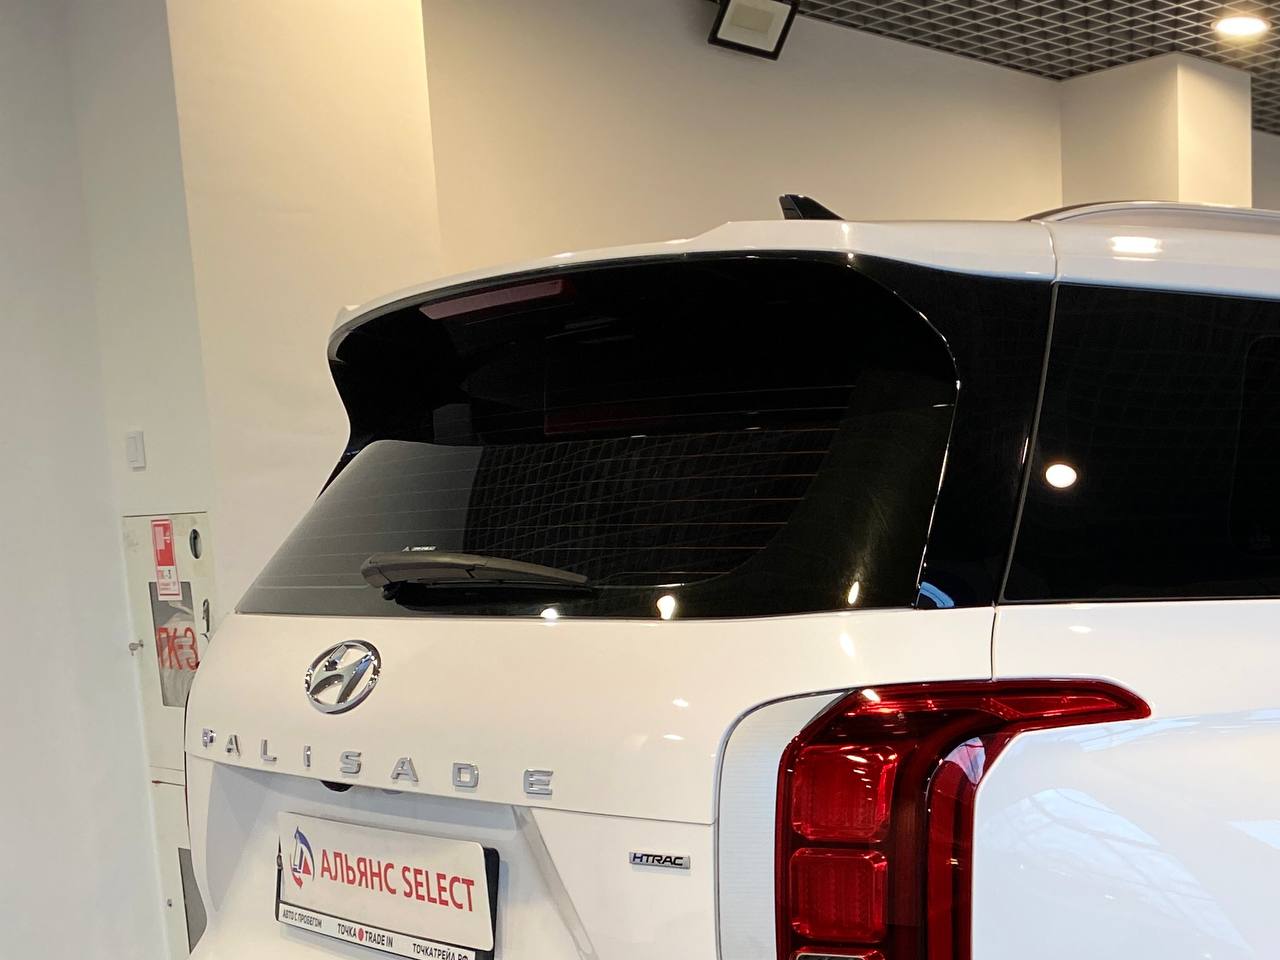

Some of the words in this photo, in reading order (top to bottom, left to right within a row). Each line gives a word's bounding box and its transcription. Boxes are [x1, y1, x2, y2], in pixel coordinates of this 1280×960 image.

[202, 728, 554, 796] PALISADE
[632, 852, 684, 867] HTRAC
[321, 849, 397, 895] АЛЬЯНС
[401, 865, 475, 912] SELECT
[282, 908, 295, 921] АВТО
[298, 913, 323, 928] ПРОБЕГОМ
[337, 922, 358, 939] ТОЧКА
[364, 930, 386, 947] TRADE
[386, 935, 394, 948] IN
